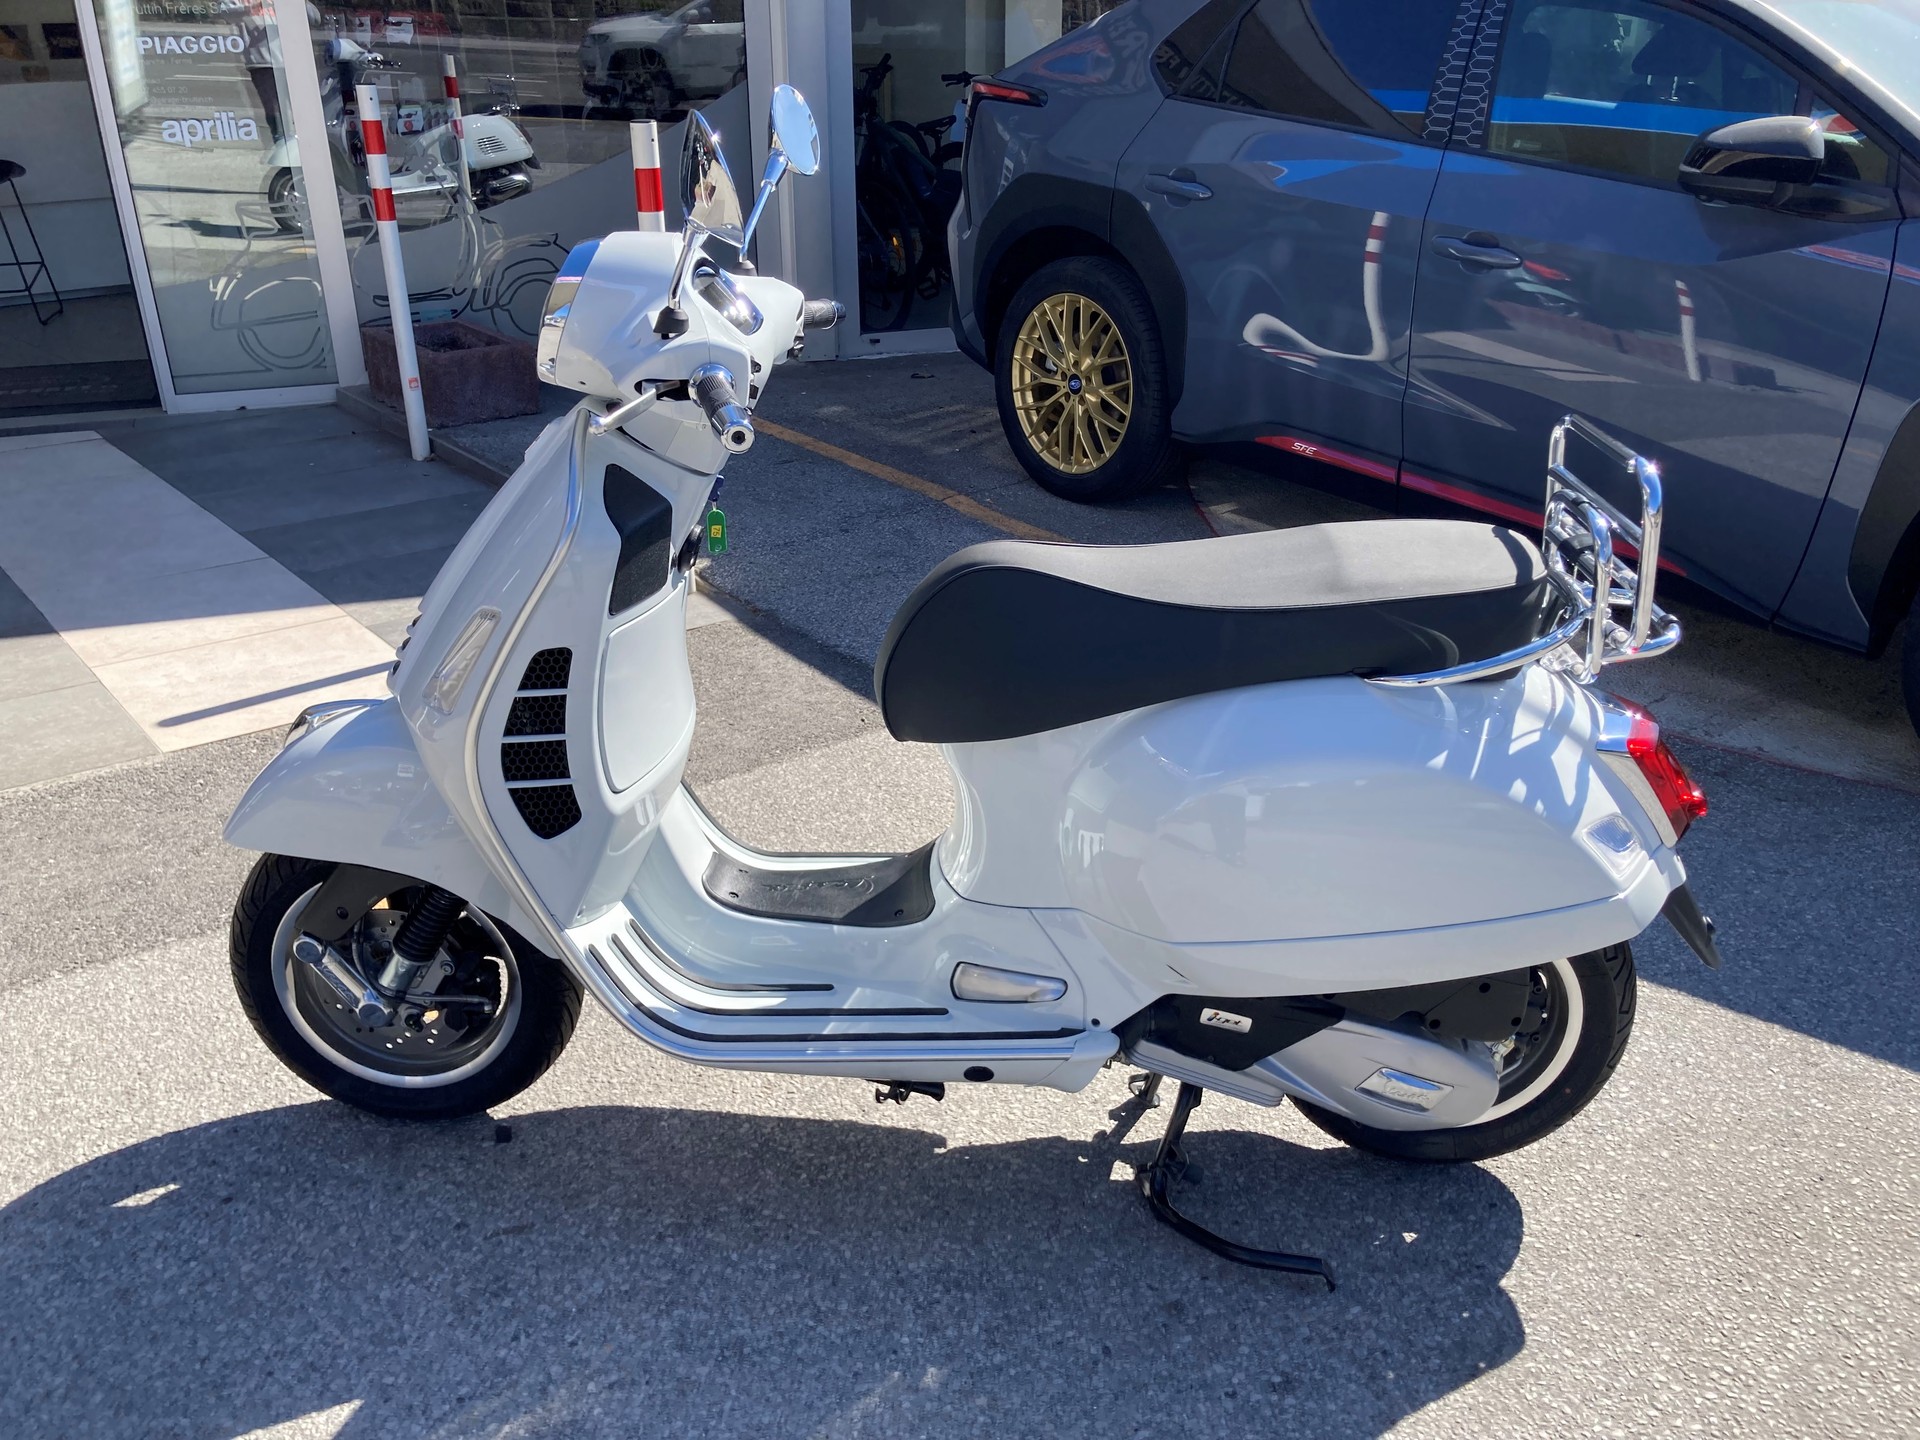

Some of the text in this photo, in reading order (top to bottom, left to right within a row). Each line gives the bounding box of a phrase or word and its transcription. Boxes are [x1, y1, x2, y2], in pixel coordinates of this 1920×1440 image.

[135, 1, 229, 15] uttin Frères SA
[136, 35, 246, 55] PIAGGIO
[161, 111, 259, 148] aprilia
